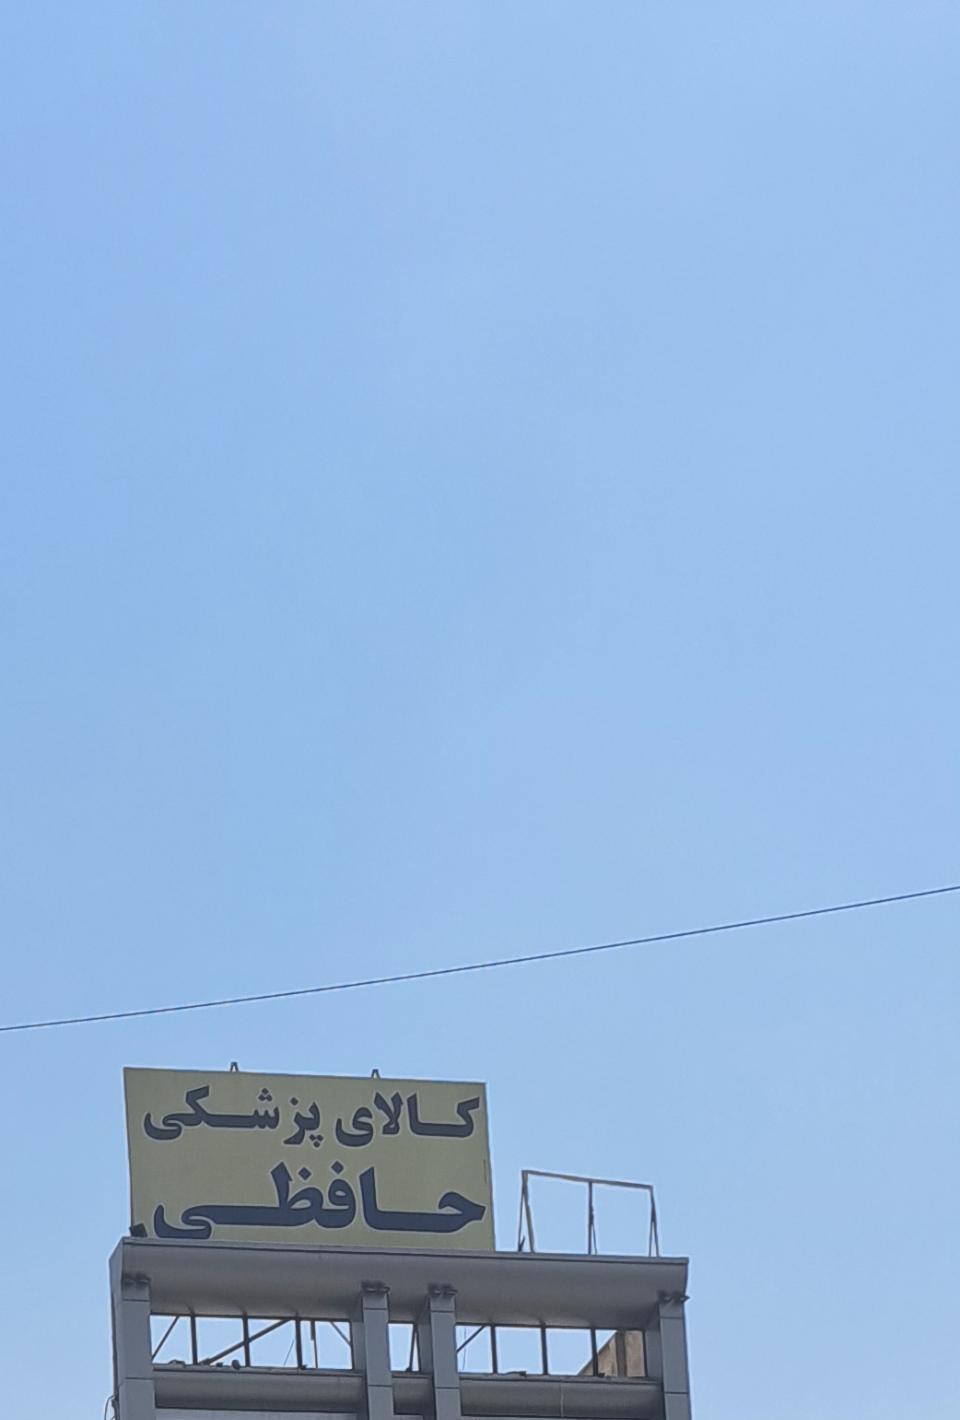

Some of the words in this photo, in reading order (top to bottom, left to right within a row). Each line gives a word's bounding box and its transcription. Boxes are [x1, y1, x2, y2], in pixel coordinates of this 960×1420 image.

[143, 1085, 324, 1148] پزشکی
[335, 1092, 480, 1147] کالای
[153, 1160, 487, 1240] حافظی
